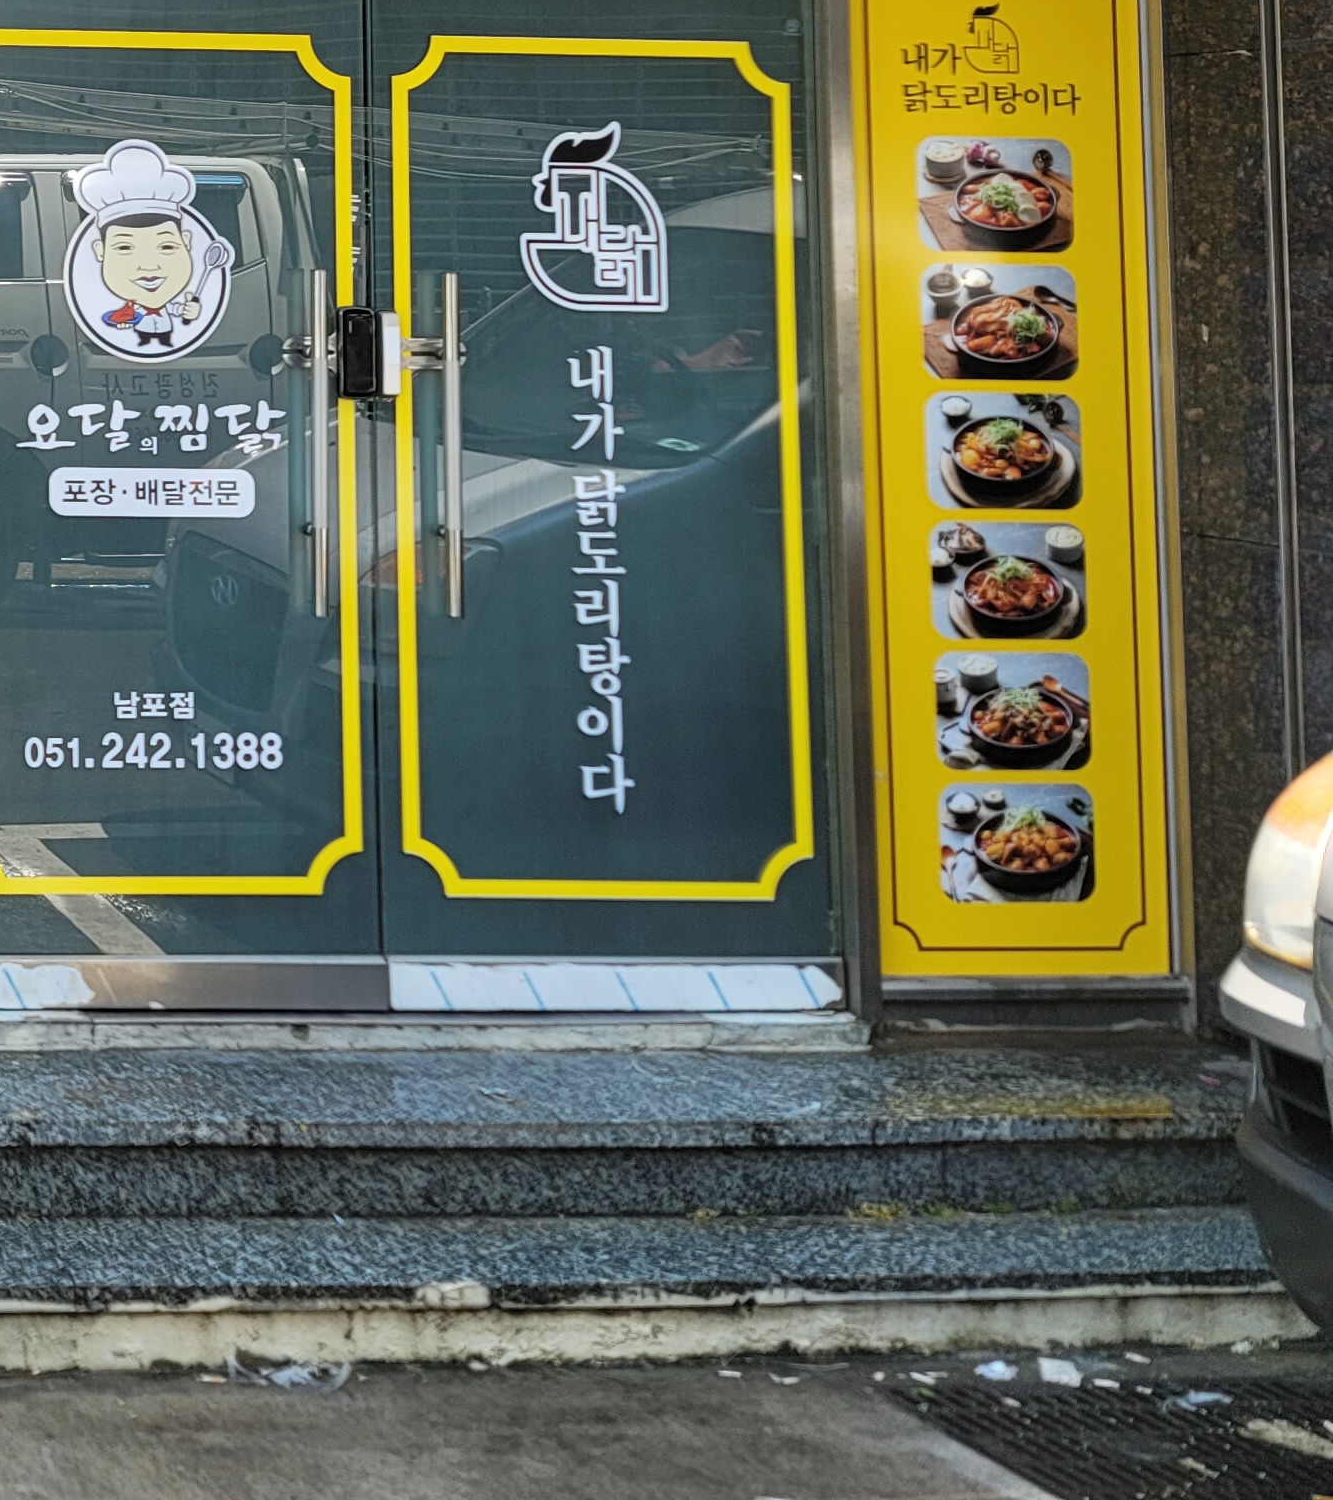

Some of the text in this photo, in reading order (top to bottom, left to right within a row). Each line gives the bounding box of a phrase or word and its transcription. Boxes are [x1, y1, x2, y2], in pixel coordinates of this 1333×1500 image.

[901, 42, 963, 75] 내가
[902, 80, 1082, 116] 닭도리탕이다
[566, 345, 636, 814] 내가 닭도리탕이다
[113, 691, 195, 720] 남포점
[24, 731, 284, 770] 051.242.1388
